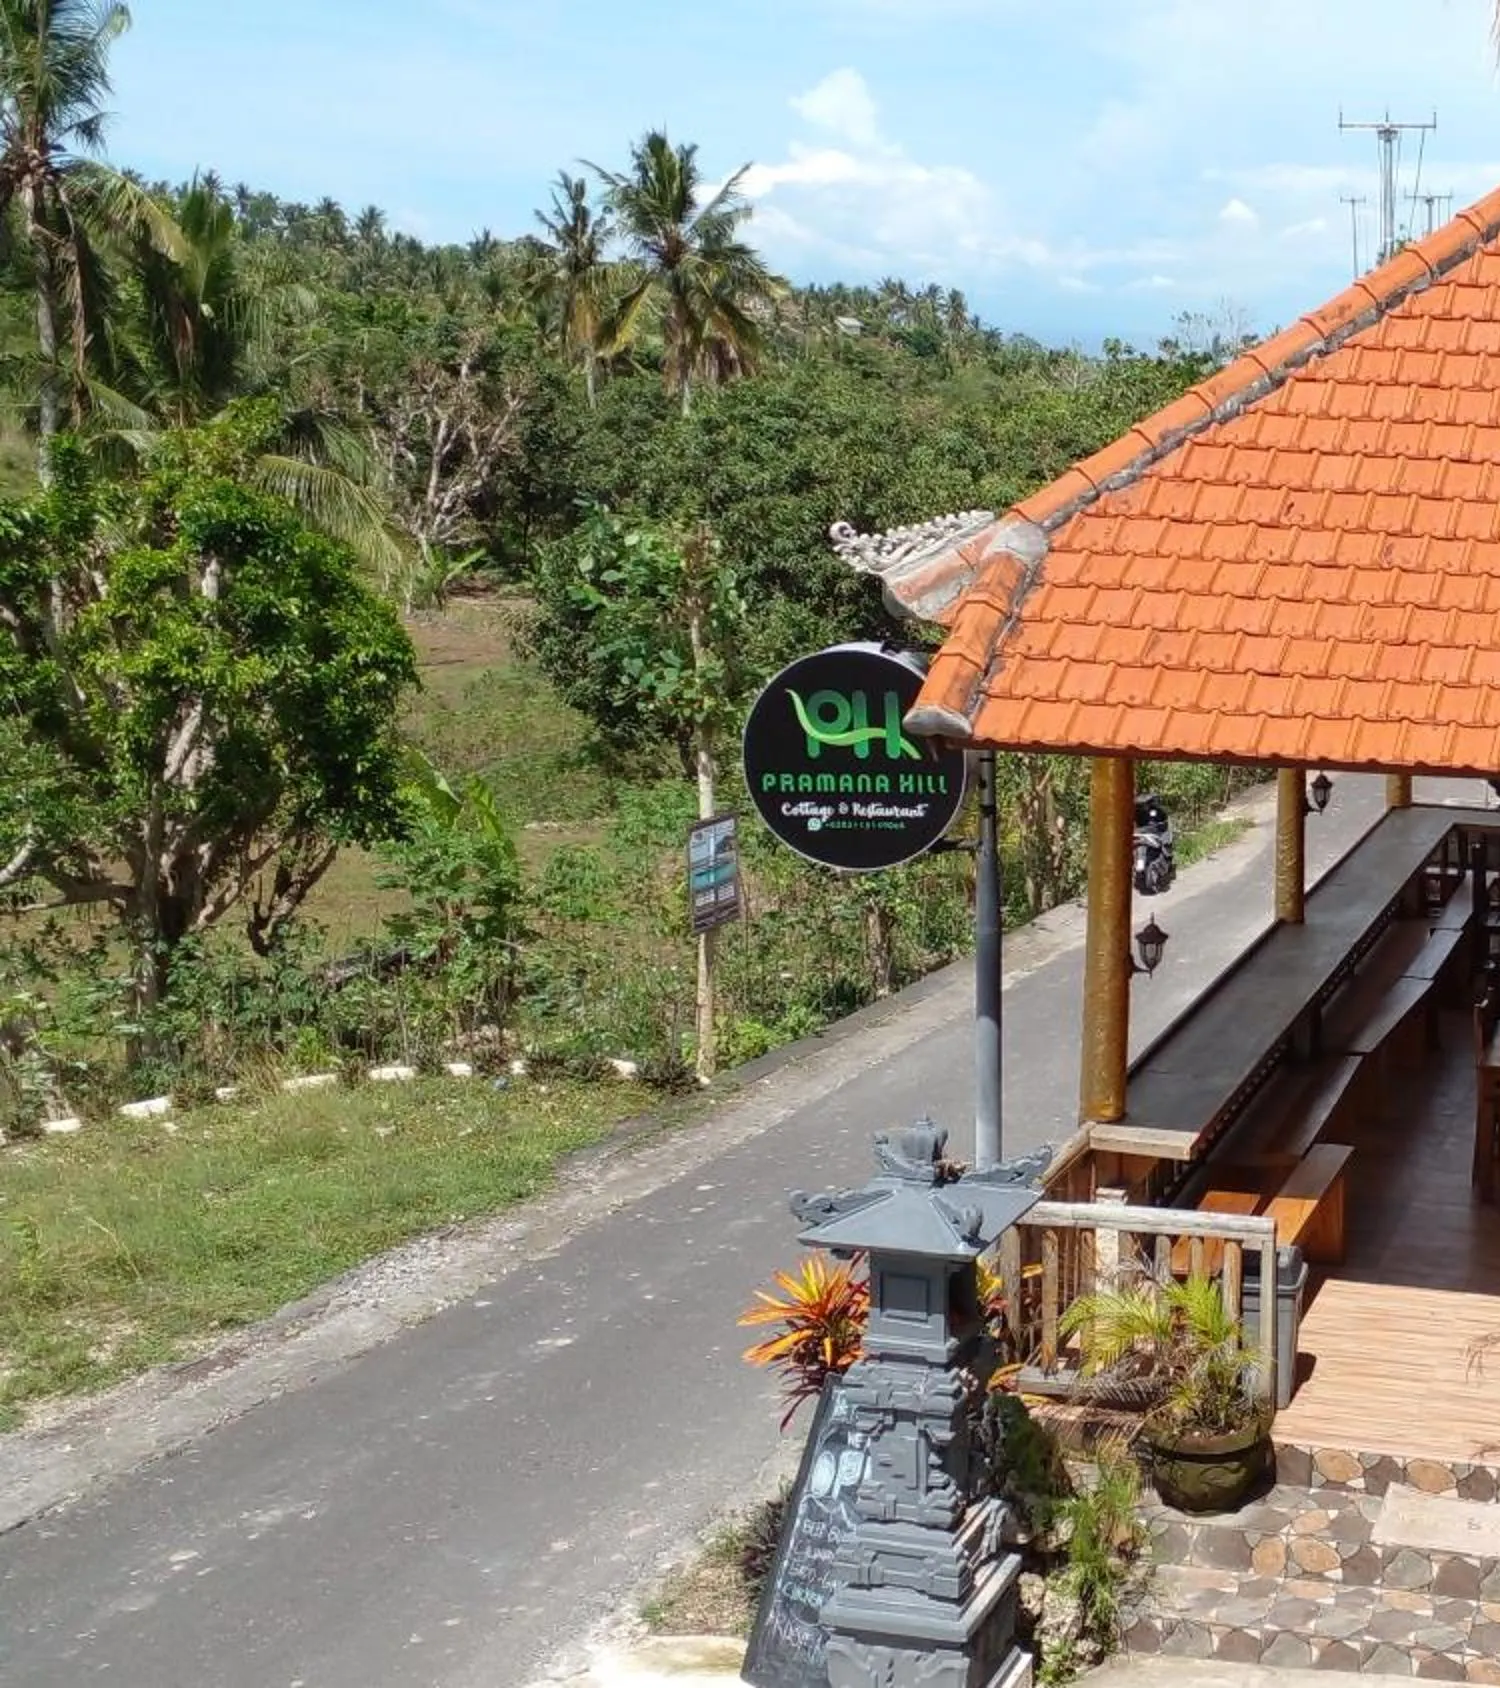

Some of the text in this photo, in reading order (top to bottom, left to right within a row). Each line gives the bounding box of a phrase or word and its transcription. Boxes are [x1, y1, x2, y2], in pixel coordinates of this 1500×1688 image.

[762, 773, 948, 795] PRAMANA HILL
[781, 801, 929, 821] Cottage & Restaurant
